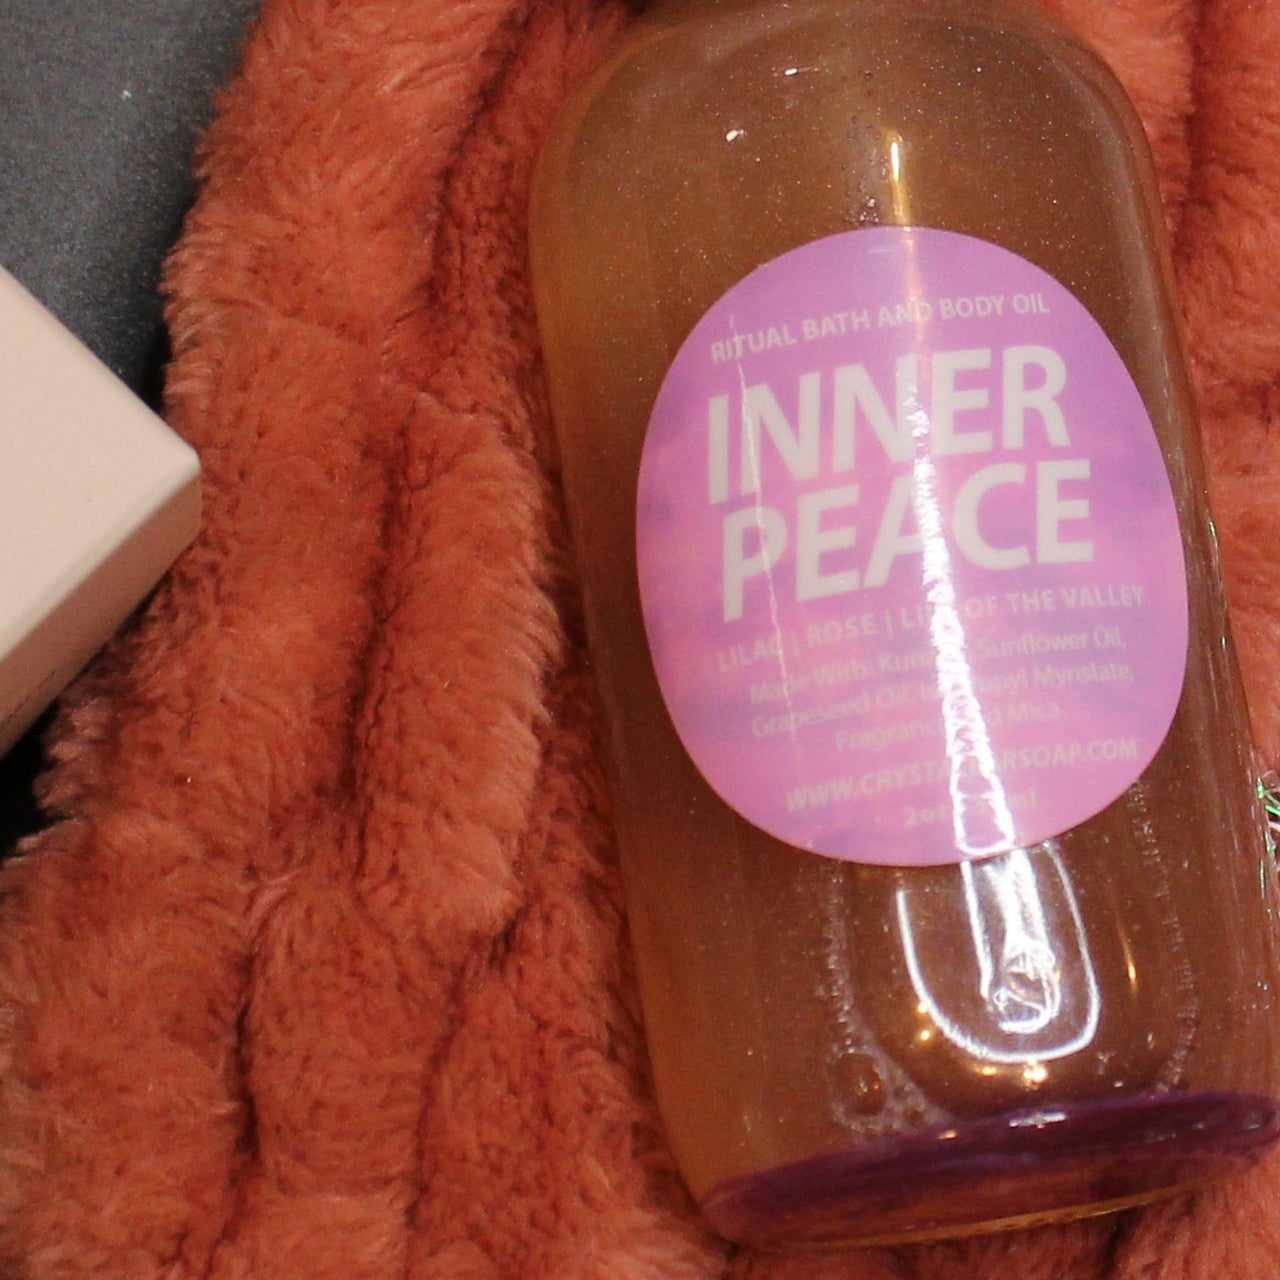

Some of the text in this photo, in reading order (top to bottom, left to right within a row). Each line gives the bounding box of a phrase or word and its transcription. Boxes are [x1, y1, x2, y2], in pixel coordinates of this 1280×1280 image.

[711, 293, 1050, 364] RITUAL BATH AND BODY OIL
[708, 344, 1071, 506] INNER
[721, 458, 1095, 623] PEACE
[718, 636, 783, 673] LILAC
[805, 613, 876, 647] ROSE
[965, 596, 1000, 618] OF
[1007, 589, 1057, 613] THE
[1061, 584, 1145, 610] VALLEY
[977, 630, 1089, 660] Sunflower
[836, 720, 945, 751] Fragranc
